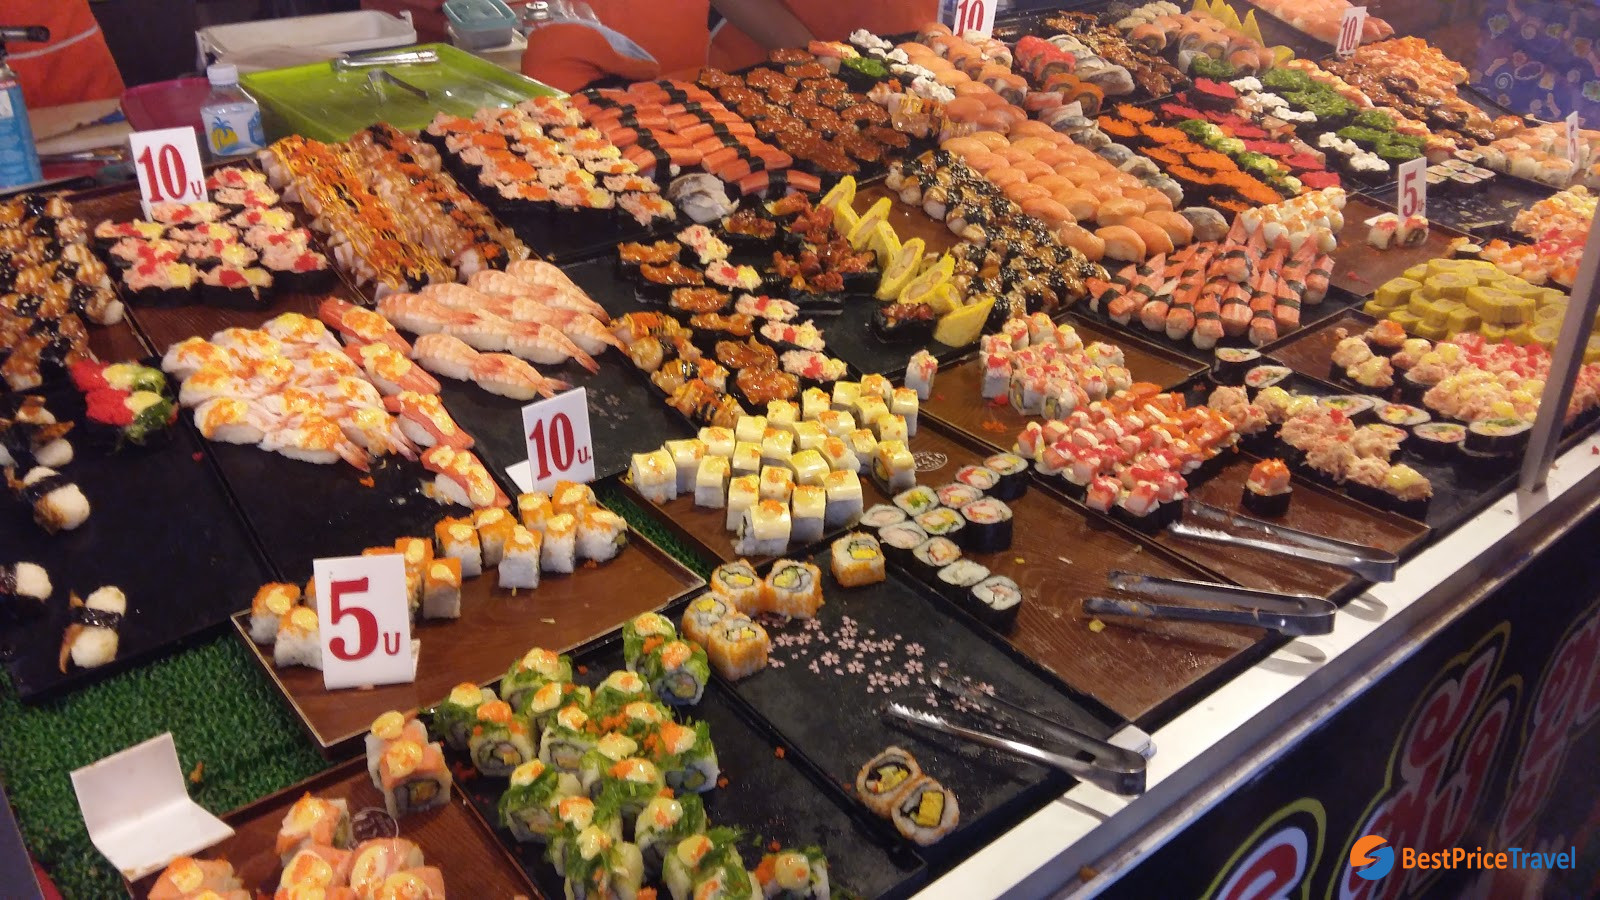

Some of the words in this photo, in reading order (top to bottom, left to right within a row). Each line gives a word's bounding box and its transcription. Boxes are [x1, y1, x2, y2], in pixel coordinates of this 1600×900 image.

[956, 0, 984, 37] 10
[1339, 16, 1357, 52] 10
[1403, 168, 1417, 217] 5
[329, 576, 379, 662] 5
